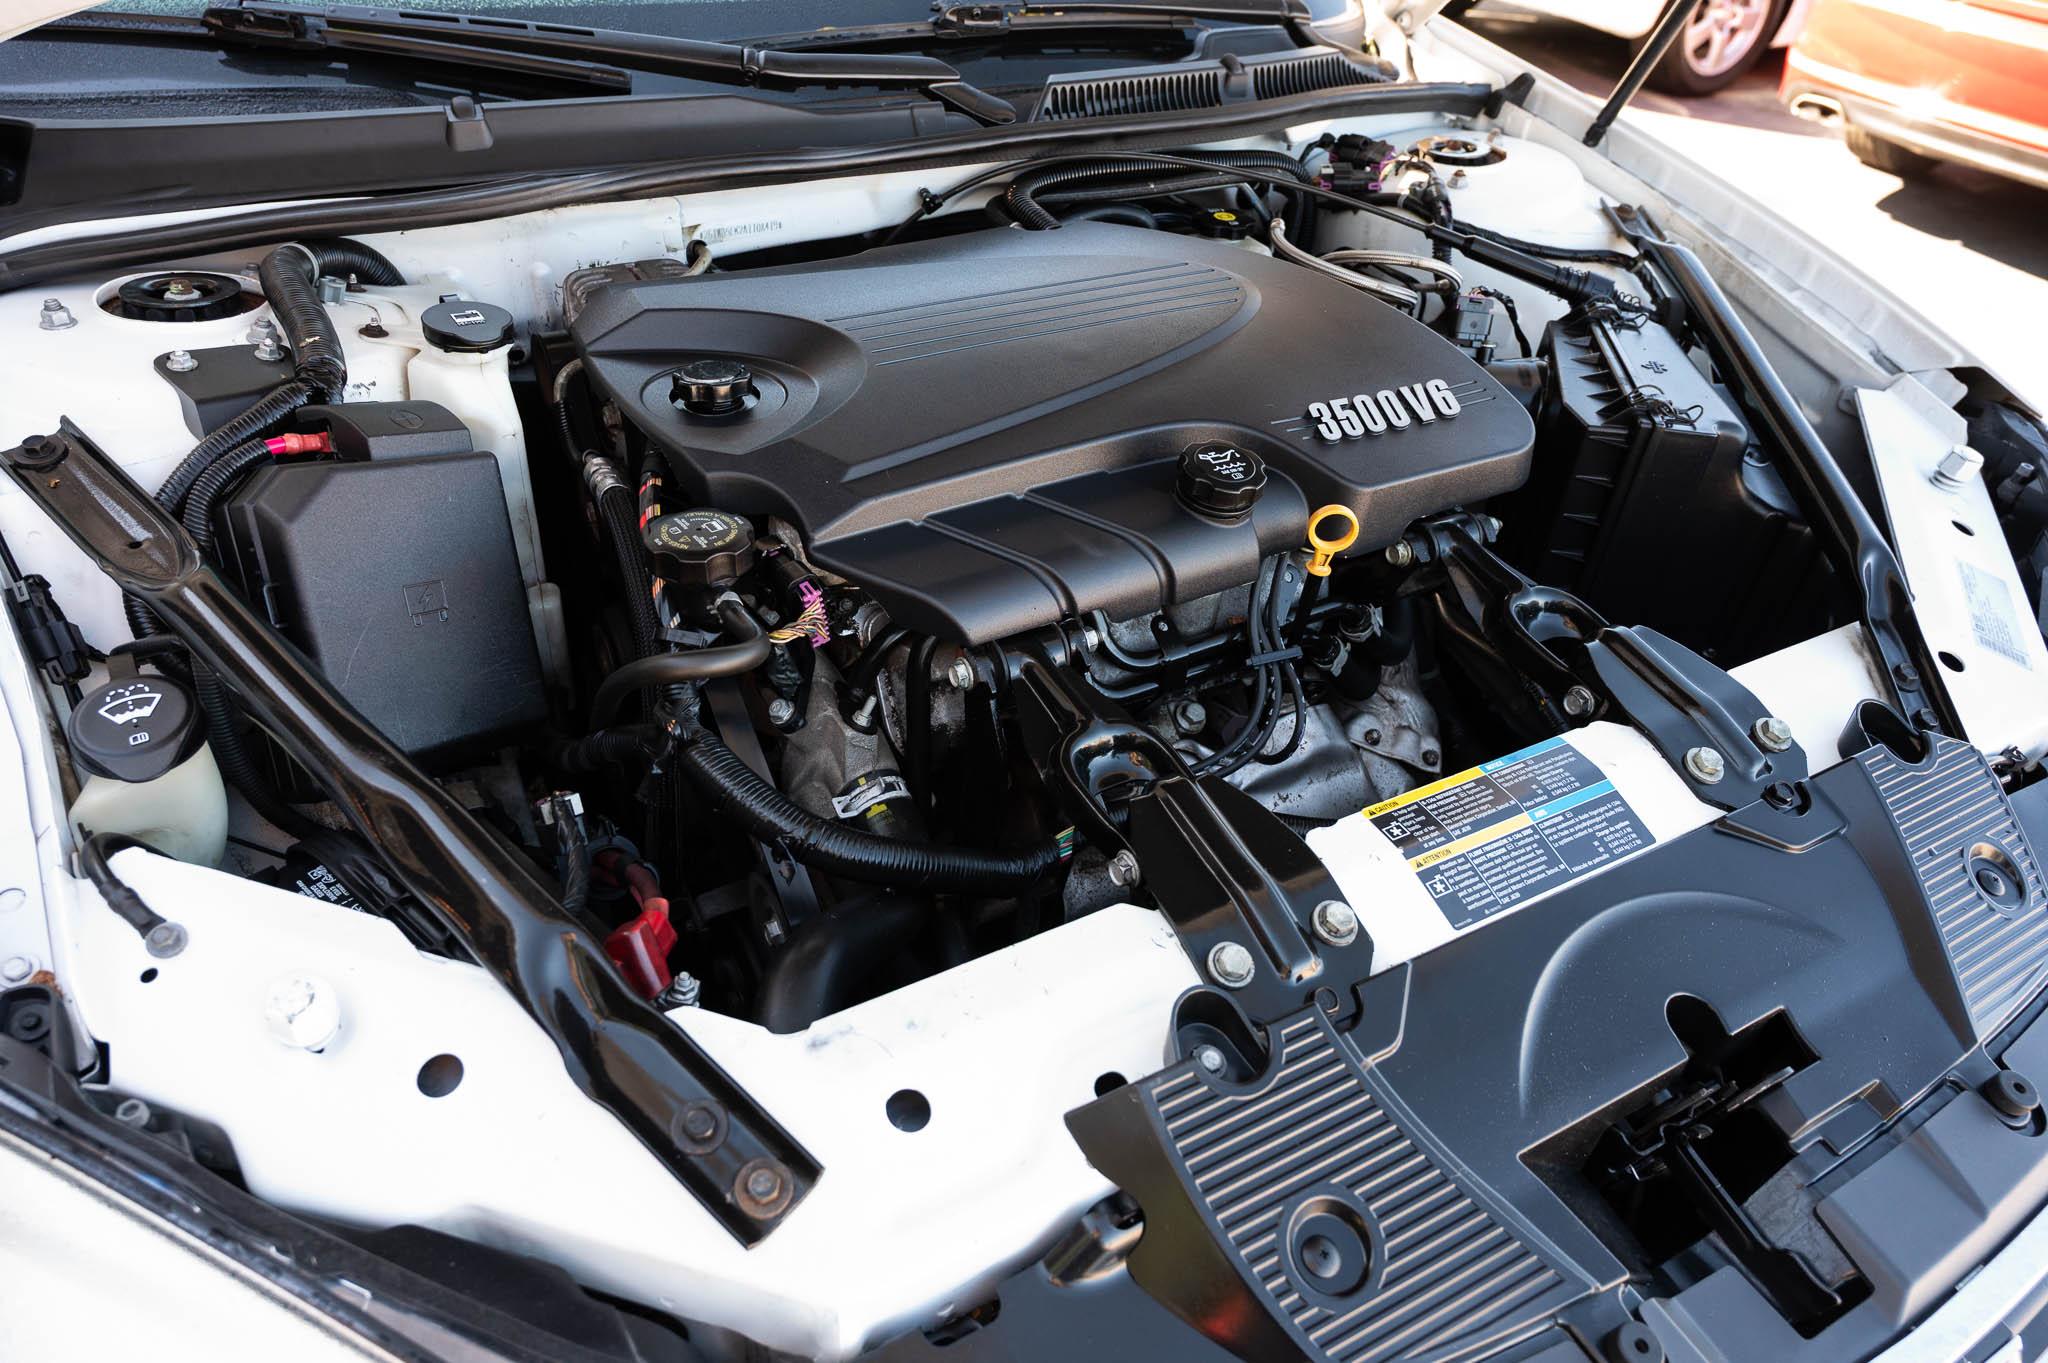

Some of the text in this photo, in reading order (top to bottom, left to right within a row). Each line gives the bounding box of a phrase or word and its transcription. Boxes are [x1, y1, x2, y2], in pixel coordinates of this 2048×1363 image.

[1375, 800, 1399, 813] CAUTION
[1421, 848, 1453, 864] ATTENTION
[316, 882, 338, 901] EXPLOSIVE
